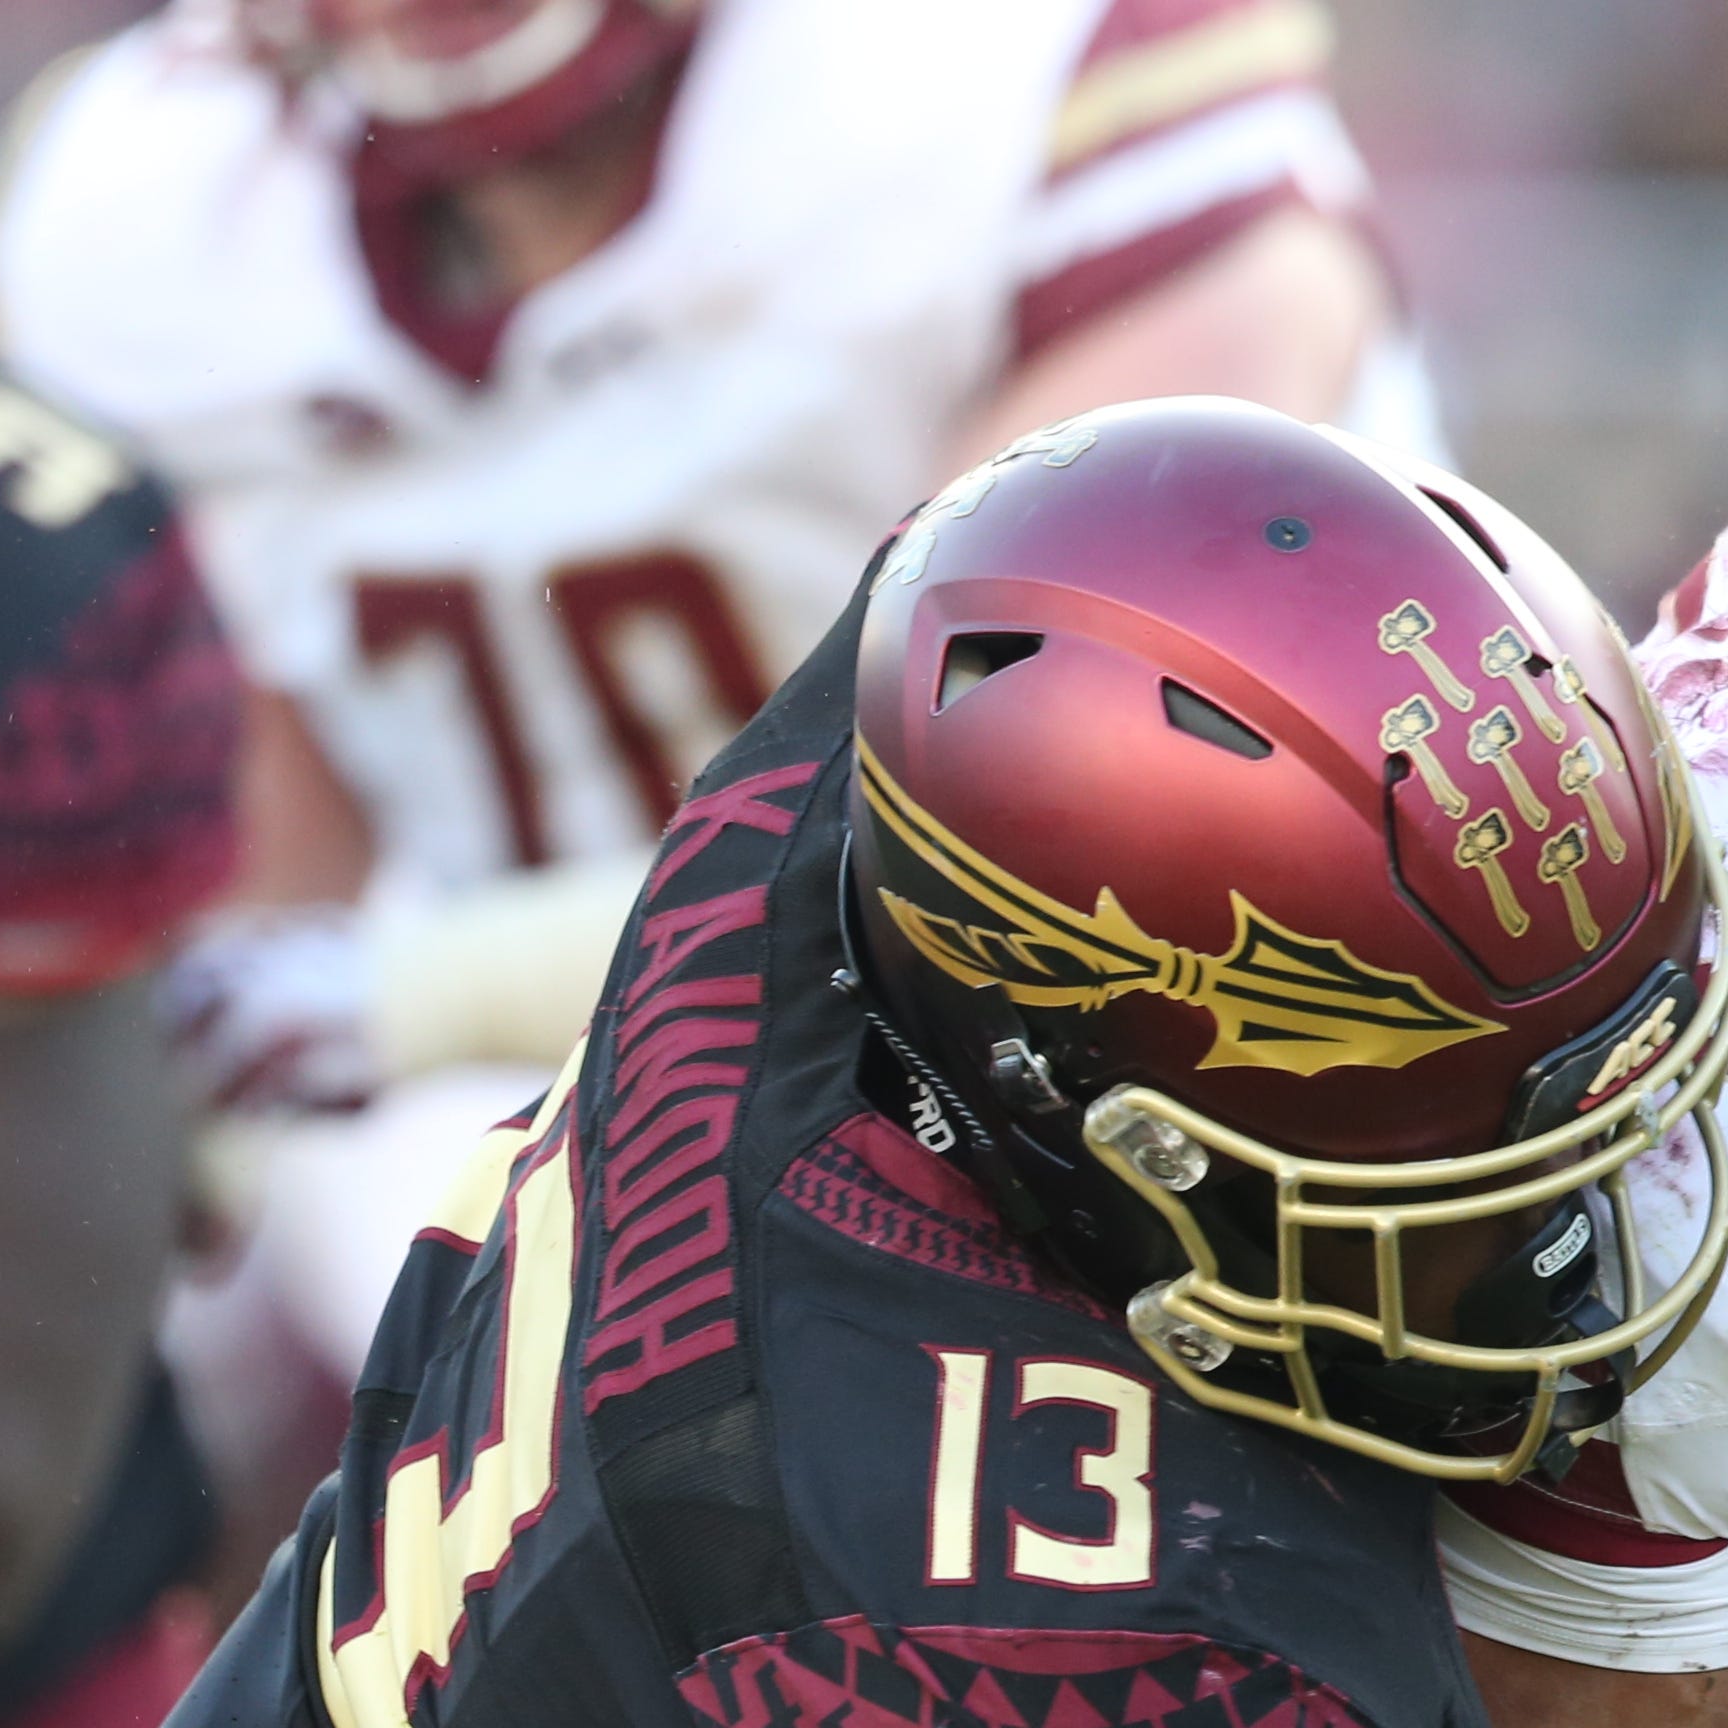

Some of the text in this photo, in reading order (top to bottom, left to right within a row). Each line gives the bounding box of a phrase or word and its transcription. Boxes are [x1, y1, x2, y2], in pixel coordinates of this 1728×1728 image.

[582, 760, 820, 1417] KAINDOH
[1587, 997, 1677, 1095] ACC
[920, 1342, 1156, 1592] 13
